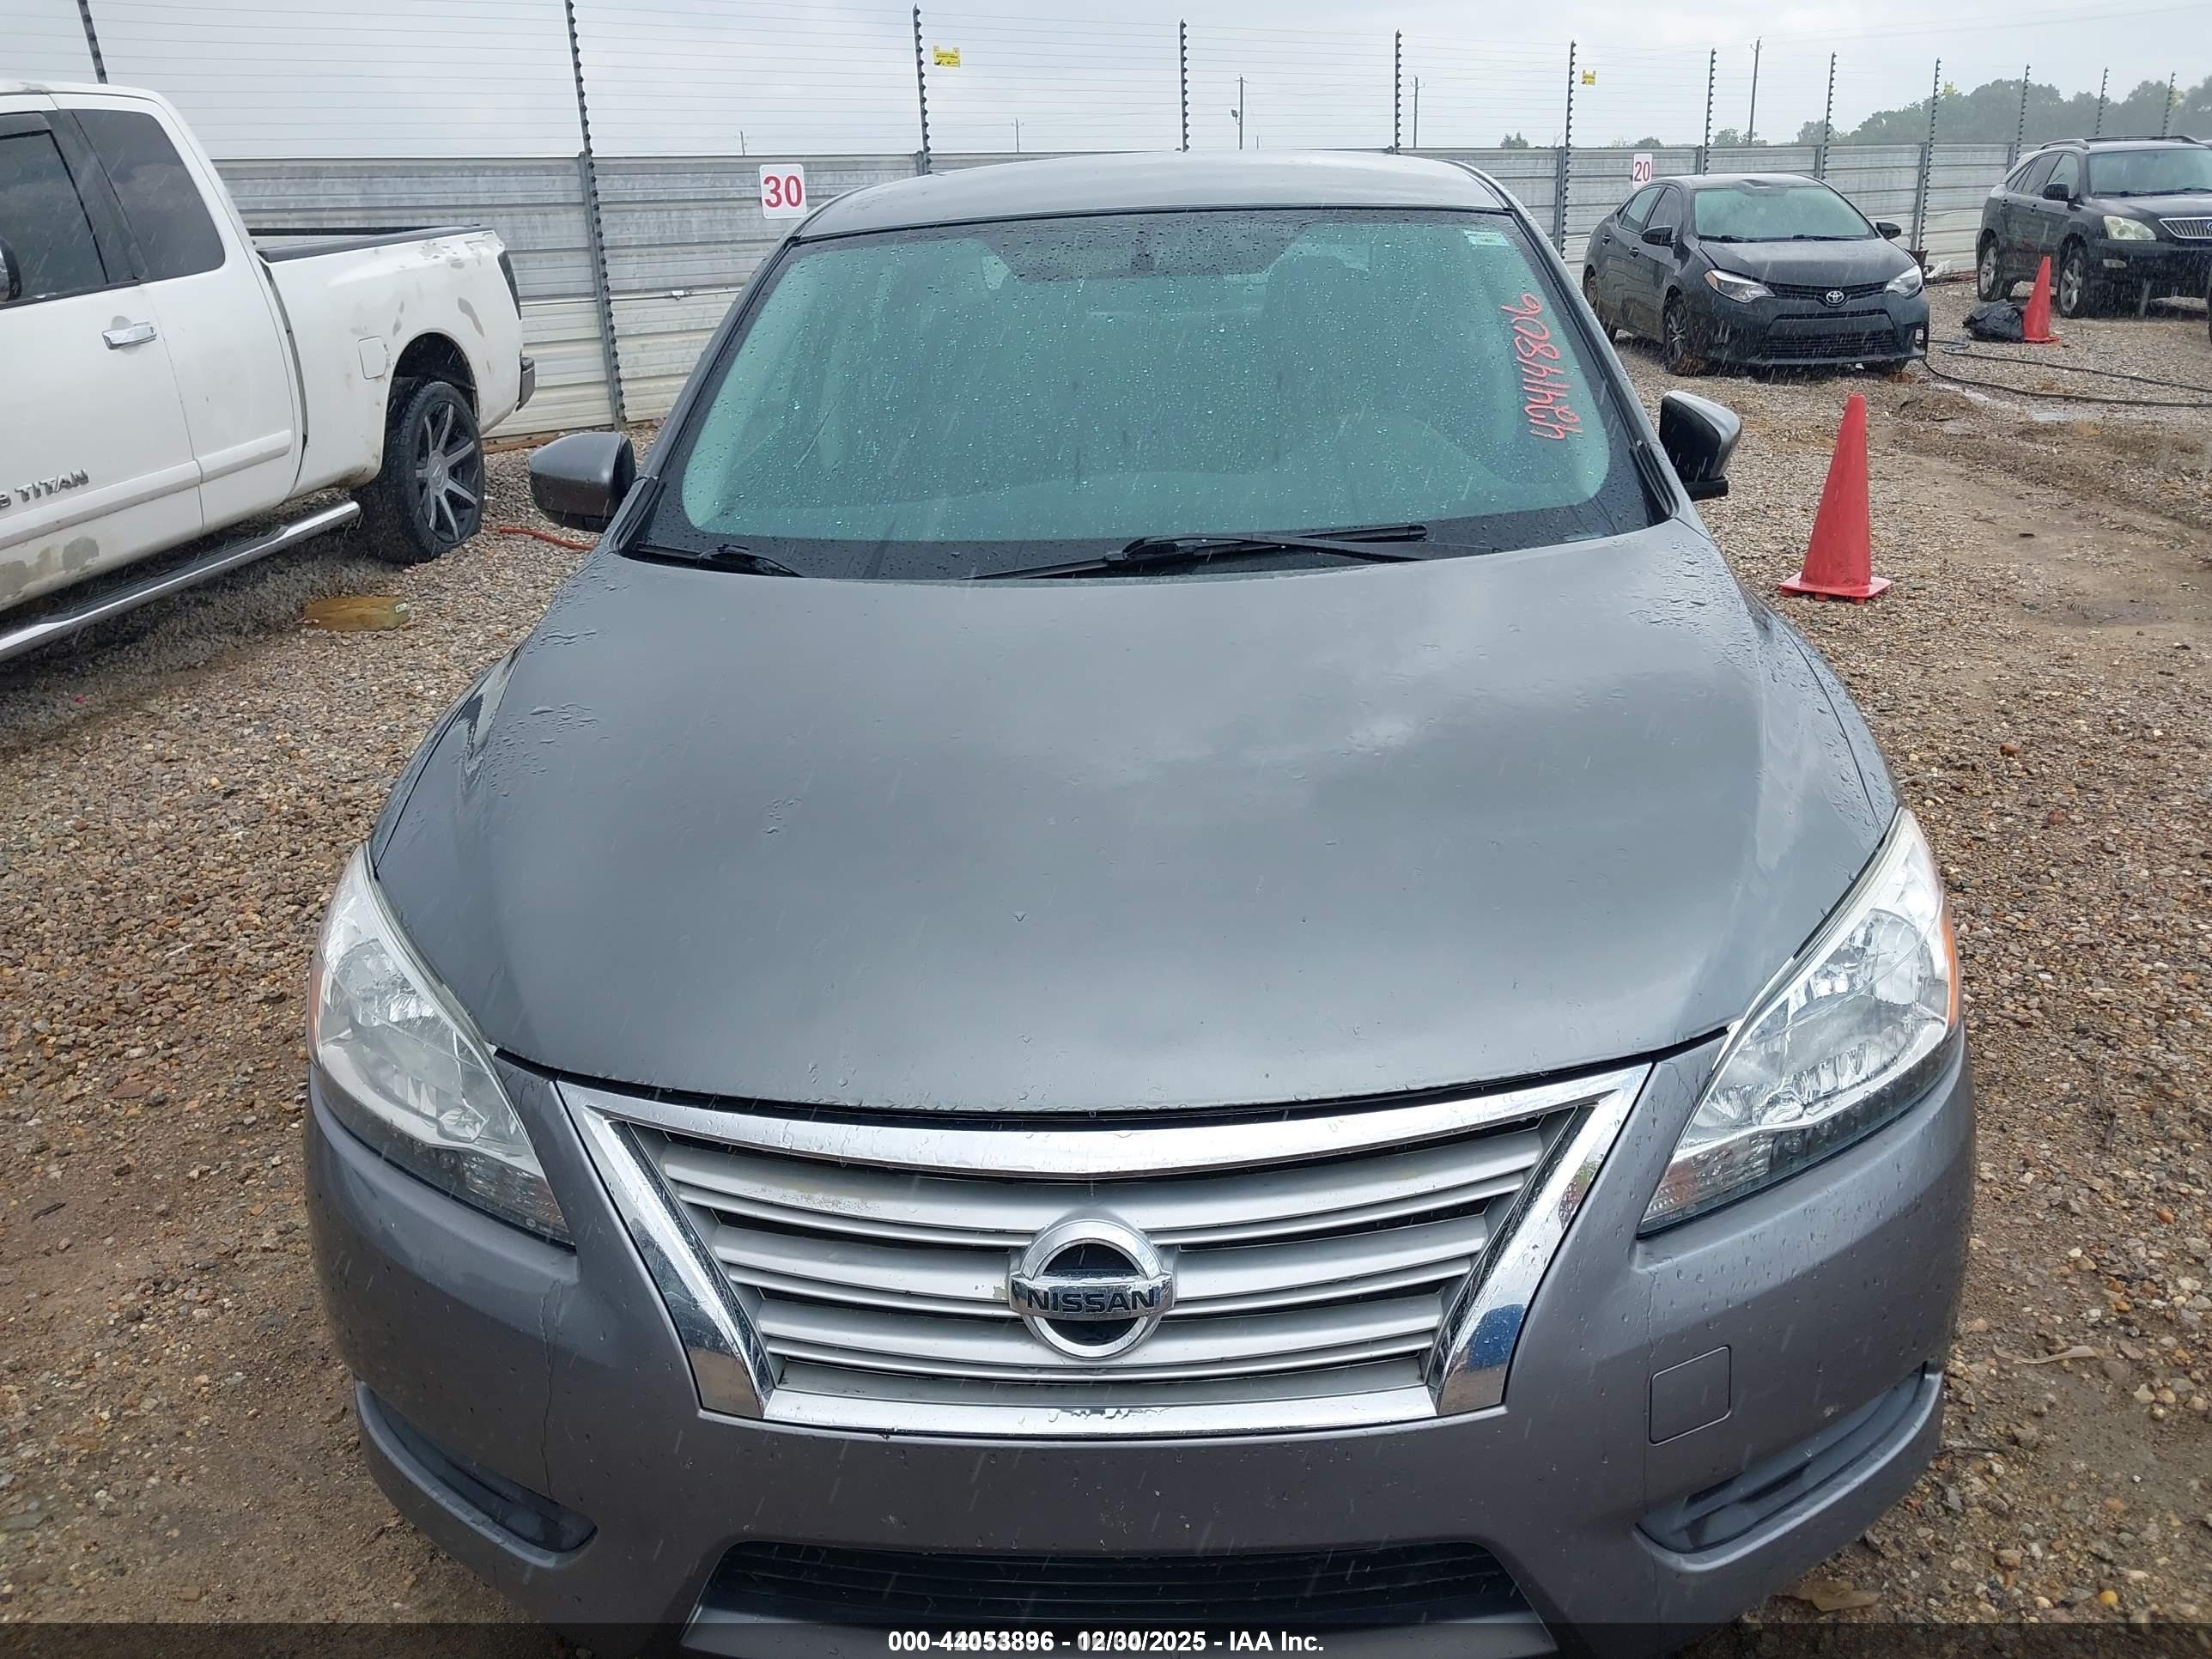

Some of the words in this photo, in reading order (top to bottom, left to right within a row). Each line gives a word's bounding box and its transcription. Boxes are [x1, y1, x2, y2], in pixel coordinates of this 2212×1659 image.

[1634, 161, 1650, 182] 20
[763, 174, 803, 208] 30
[14, 468, 89, 503] TITAN
[1027, 1288, 1154, 1313] NISSAN
